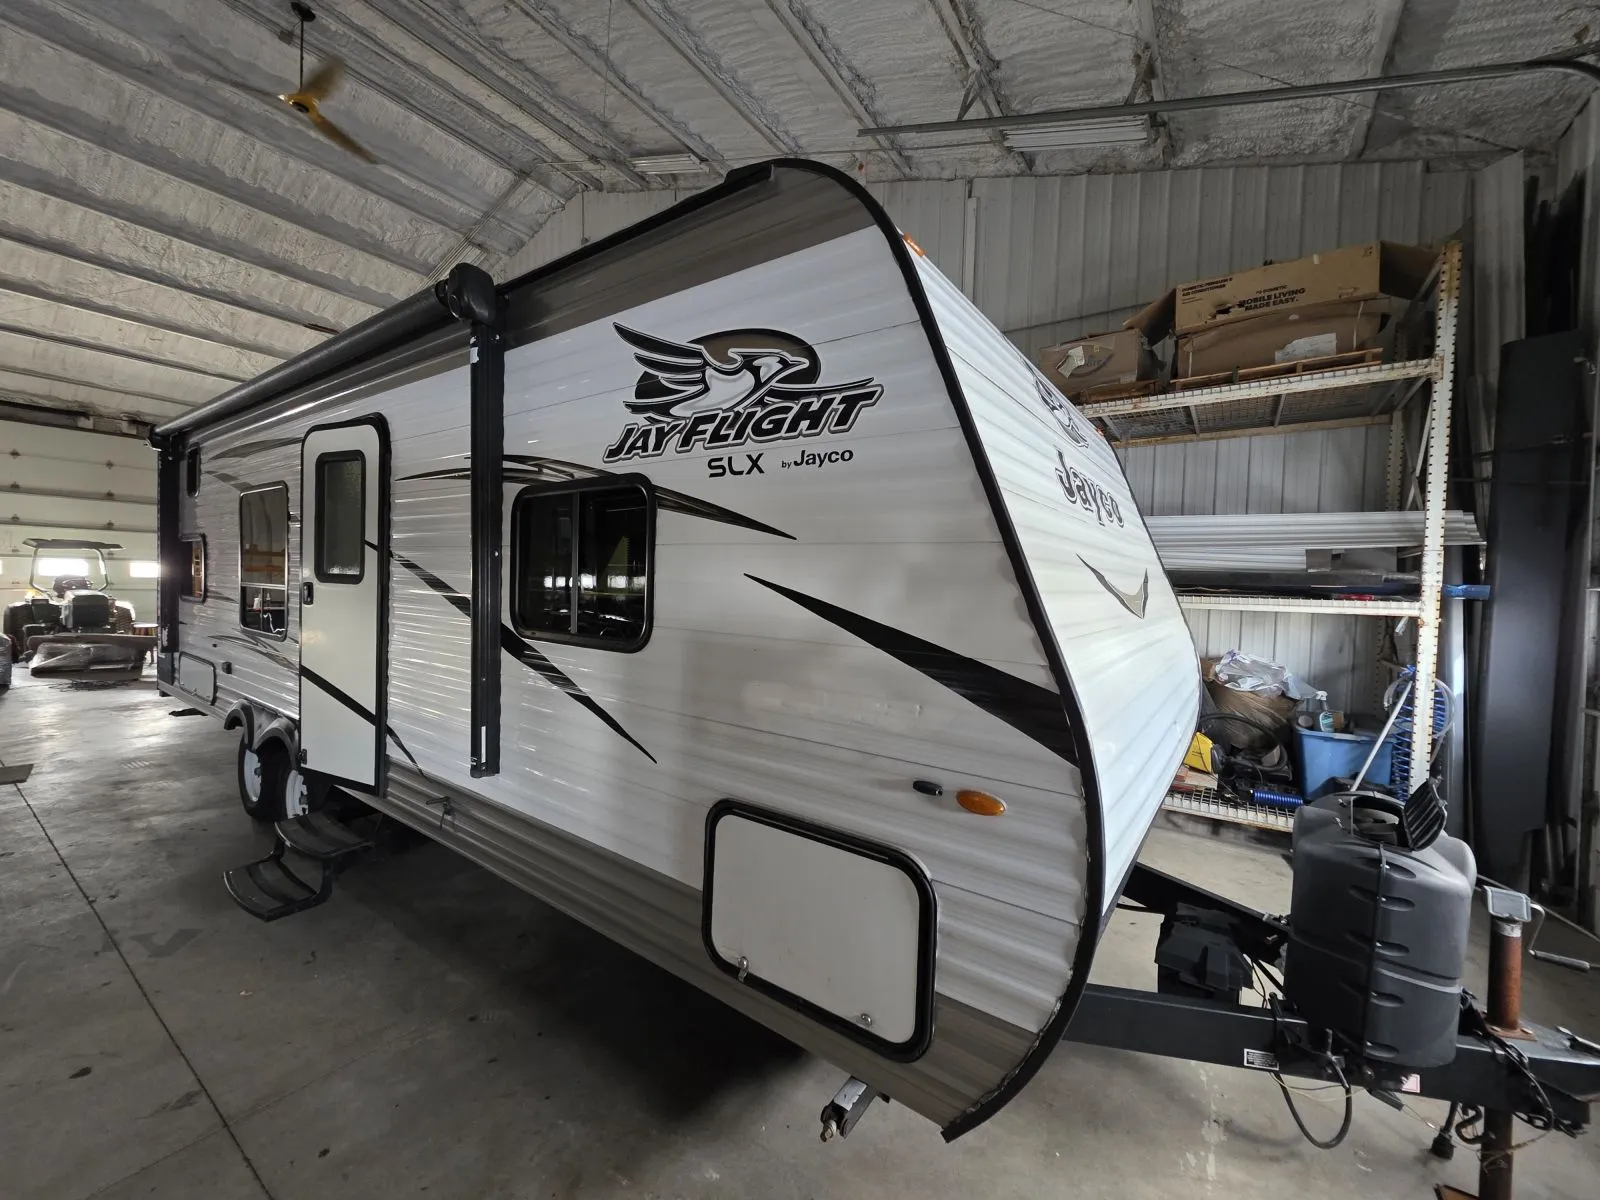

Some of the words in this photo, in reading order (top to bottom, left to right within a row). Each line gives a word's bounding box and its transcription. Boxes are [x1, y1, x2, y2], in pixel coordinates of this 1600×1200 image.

[1273, 287, 1306, 300] LIVING
[1245, 301, 1271, 312] MADE
[707, 452, 765, 478] SLX
[781, 459, 792, 469] by
[793, 449, 854, 468] Jayco
[1055, 448, 1124, 528] Jayco
